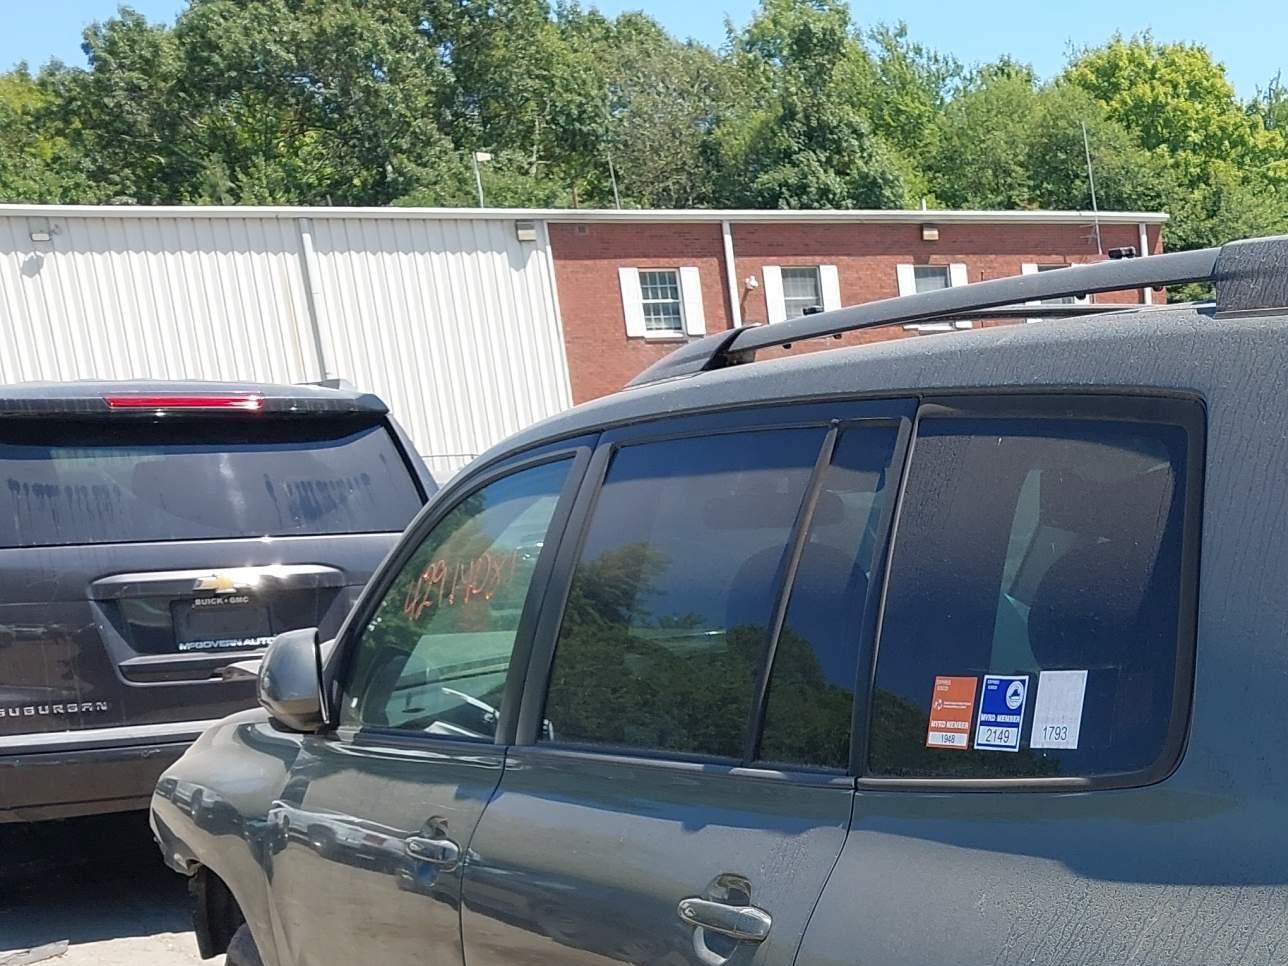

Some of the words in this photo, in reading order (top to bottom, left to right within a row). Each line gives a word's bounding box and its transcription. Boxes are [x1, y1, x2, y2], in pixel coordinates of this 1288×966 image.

[195, 597, 224, 606] BUICK
[229, 596, 249, 604] GMC
[941, 734, 956, 744] 1948
[985, 728, 1010, 743] 2149
[1042, 726, 1068, 741] 1793
